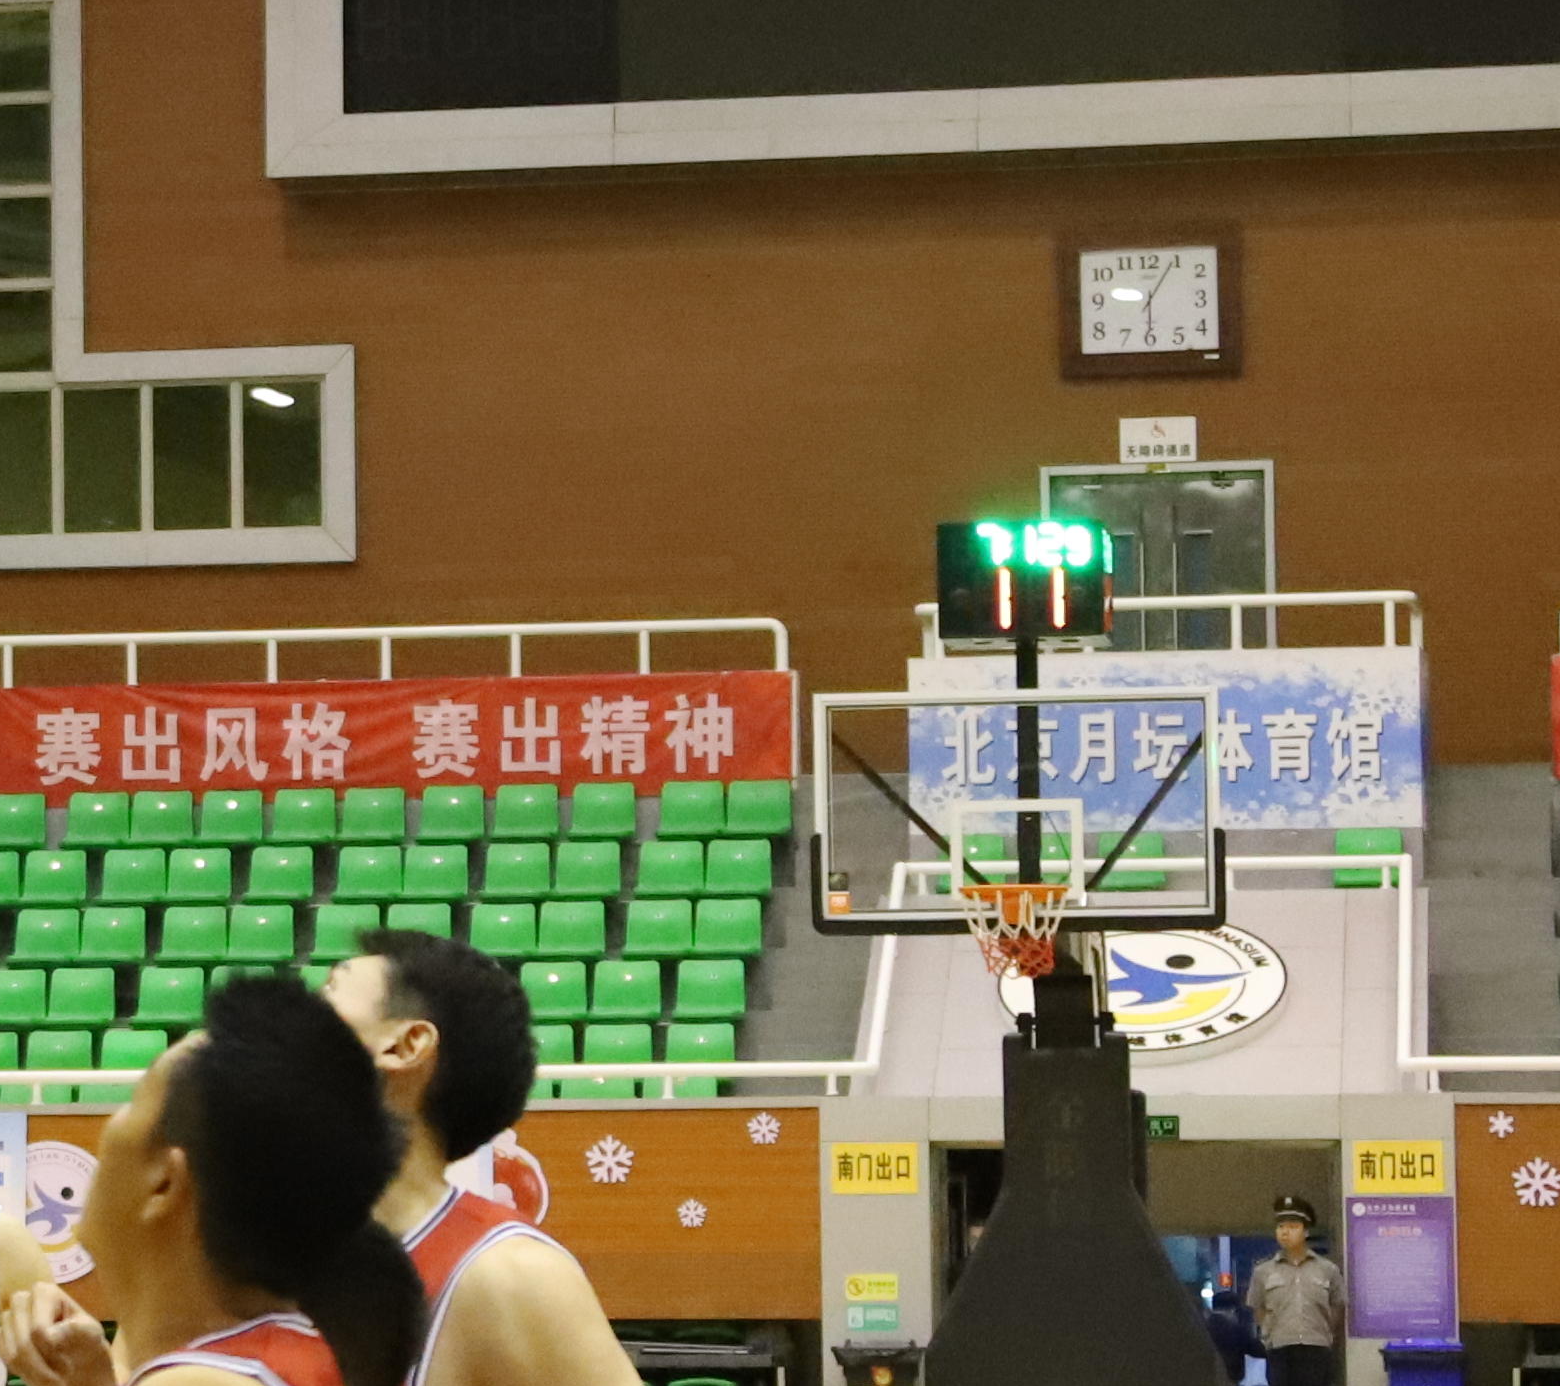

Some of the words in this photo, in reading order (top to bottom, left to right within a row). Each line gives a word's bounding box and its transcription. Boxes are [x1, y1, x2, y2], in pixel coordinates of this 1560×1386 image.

[1116, 256, 1132, 271] 11
[1139, 254, 1159, 270] 12
[1193, 263, 1206, 278] 2
[1092, 267, 1113, 282] 10
[1092, 293, 1105, 312] 9
[1194, 289, 1207, 308] 3
[1092, 321, 1106, 341] 8
[1144, 327, 1157, 346] 6
[1171, 326, 1185, 345] 5
[1195, 318, 1208, 336] 4
[1119, 328, 1132, 347] 7
[35, 702, 352, 787] 赛出风格
[411, 693, 735, 780] 赛出精神
[837, 1152, 911, 1181] 南门出口
[1358, 1150, 1436, 1180] 南门出口
